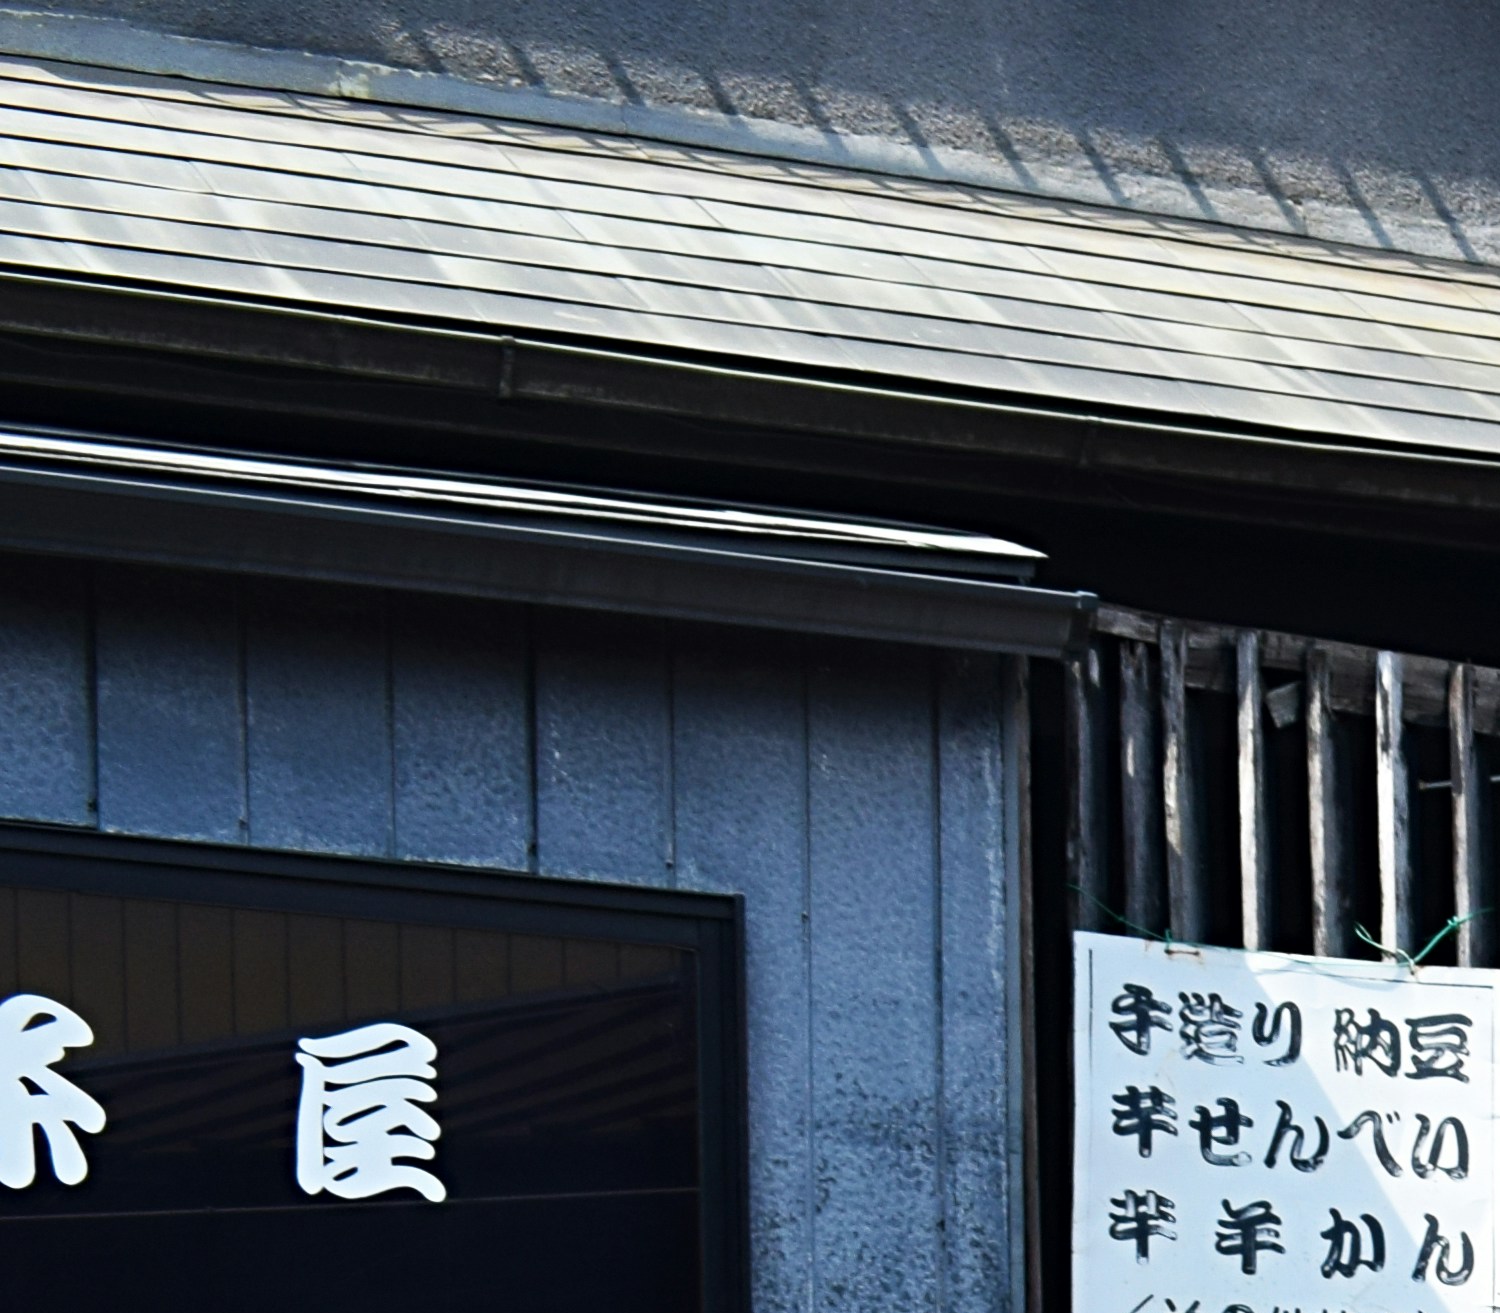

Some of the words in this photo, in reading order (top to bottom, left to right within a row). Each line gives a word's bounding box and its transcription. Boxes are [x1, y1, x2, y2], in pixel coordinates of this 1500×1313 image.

[1109, 982, 1301, 1067] 手造り
[1333, 1006, 1474, 1083] 納豆
[1109, 1084, 1470, 1181] 芋せんべい
